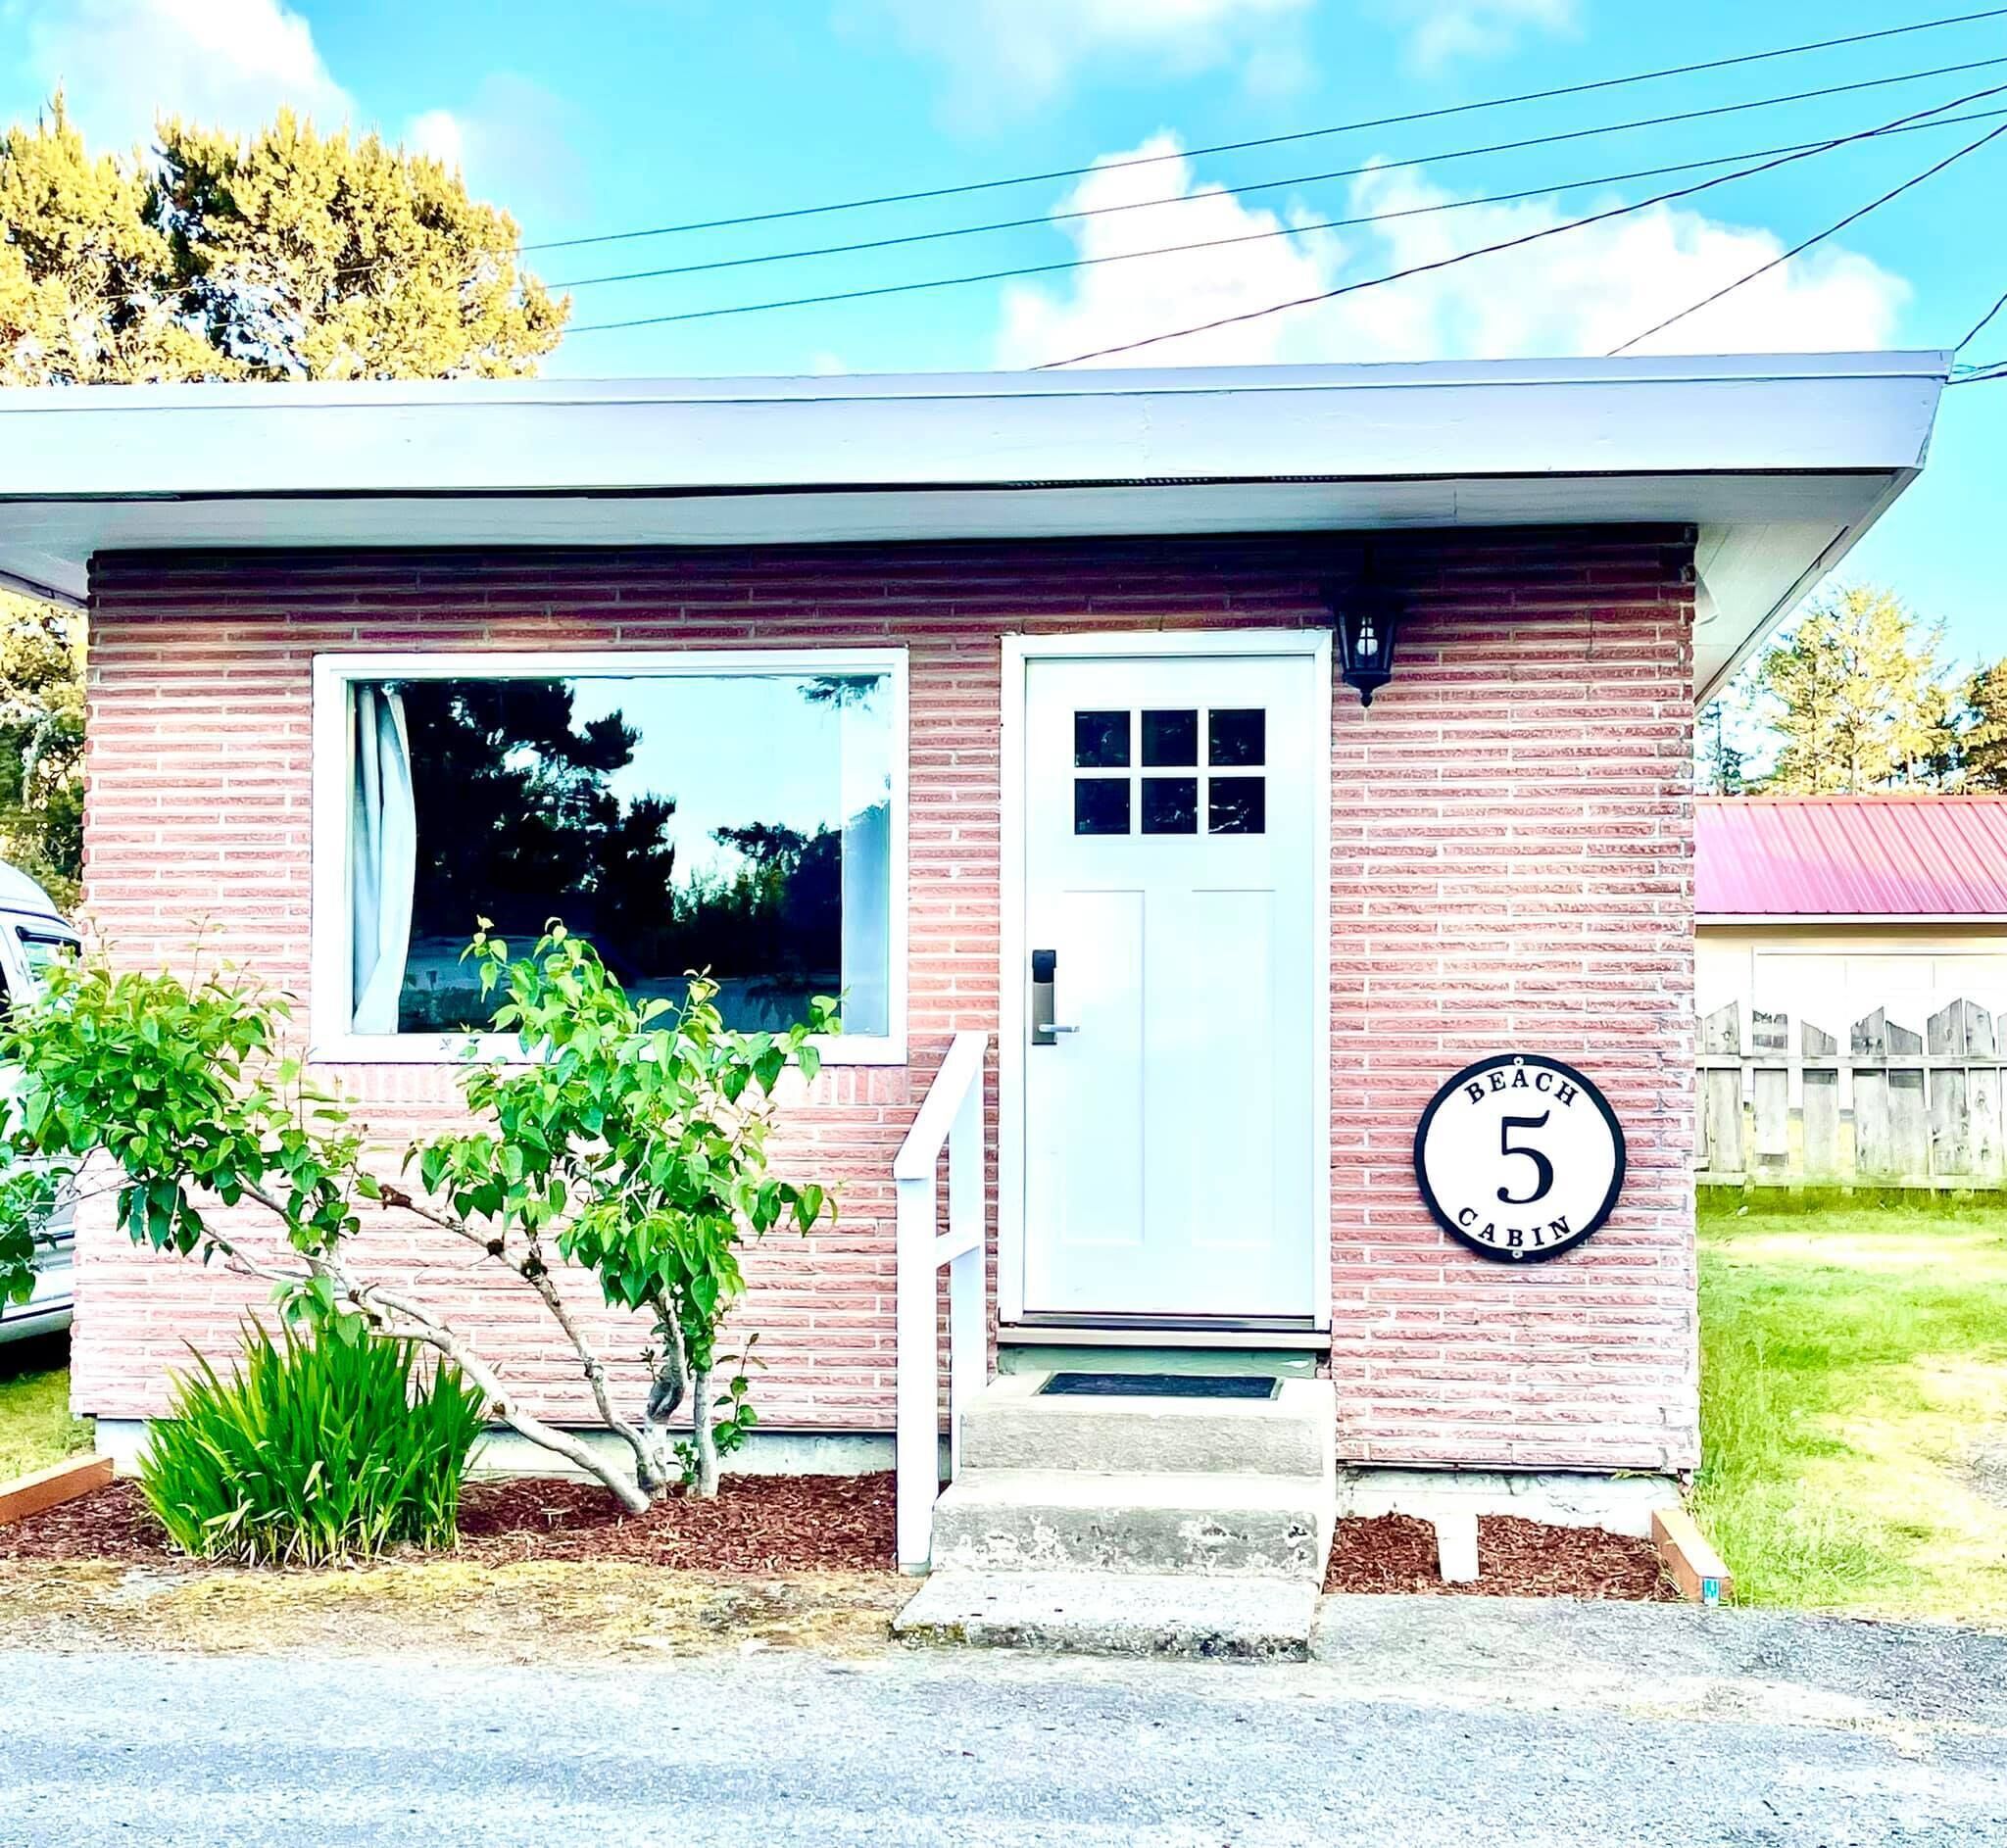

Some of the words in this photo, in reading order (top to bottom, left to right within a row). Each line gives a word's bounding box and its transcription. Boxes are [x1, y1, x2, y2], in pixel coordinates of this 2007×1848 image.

[1464, 1068, 1579, 1107] BEACH
[1496, 1109, 1554, 1204] 5
[1457, 1207, 1571, 1247] CABIN
